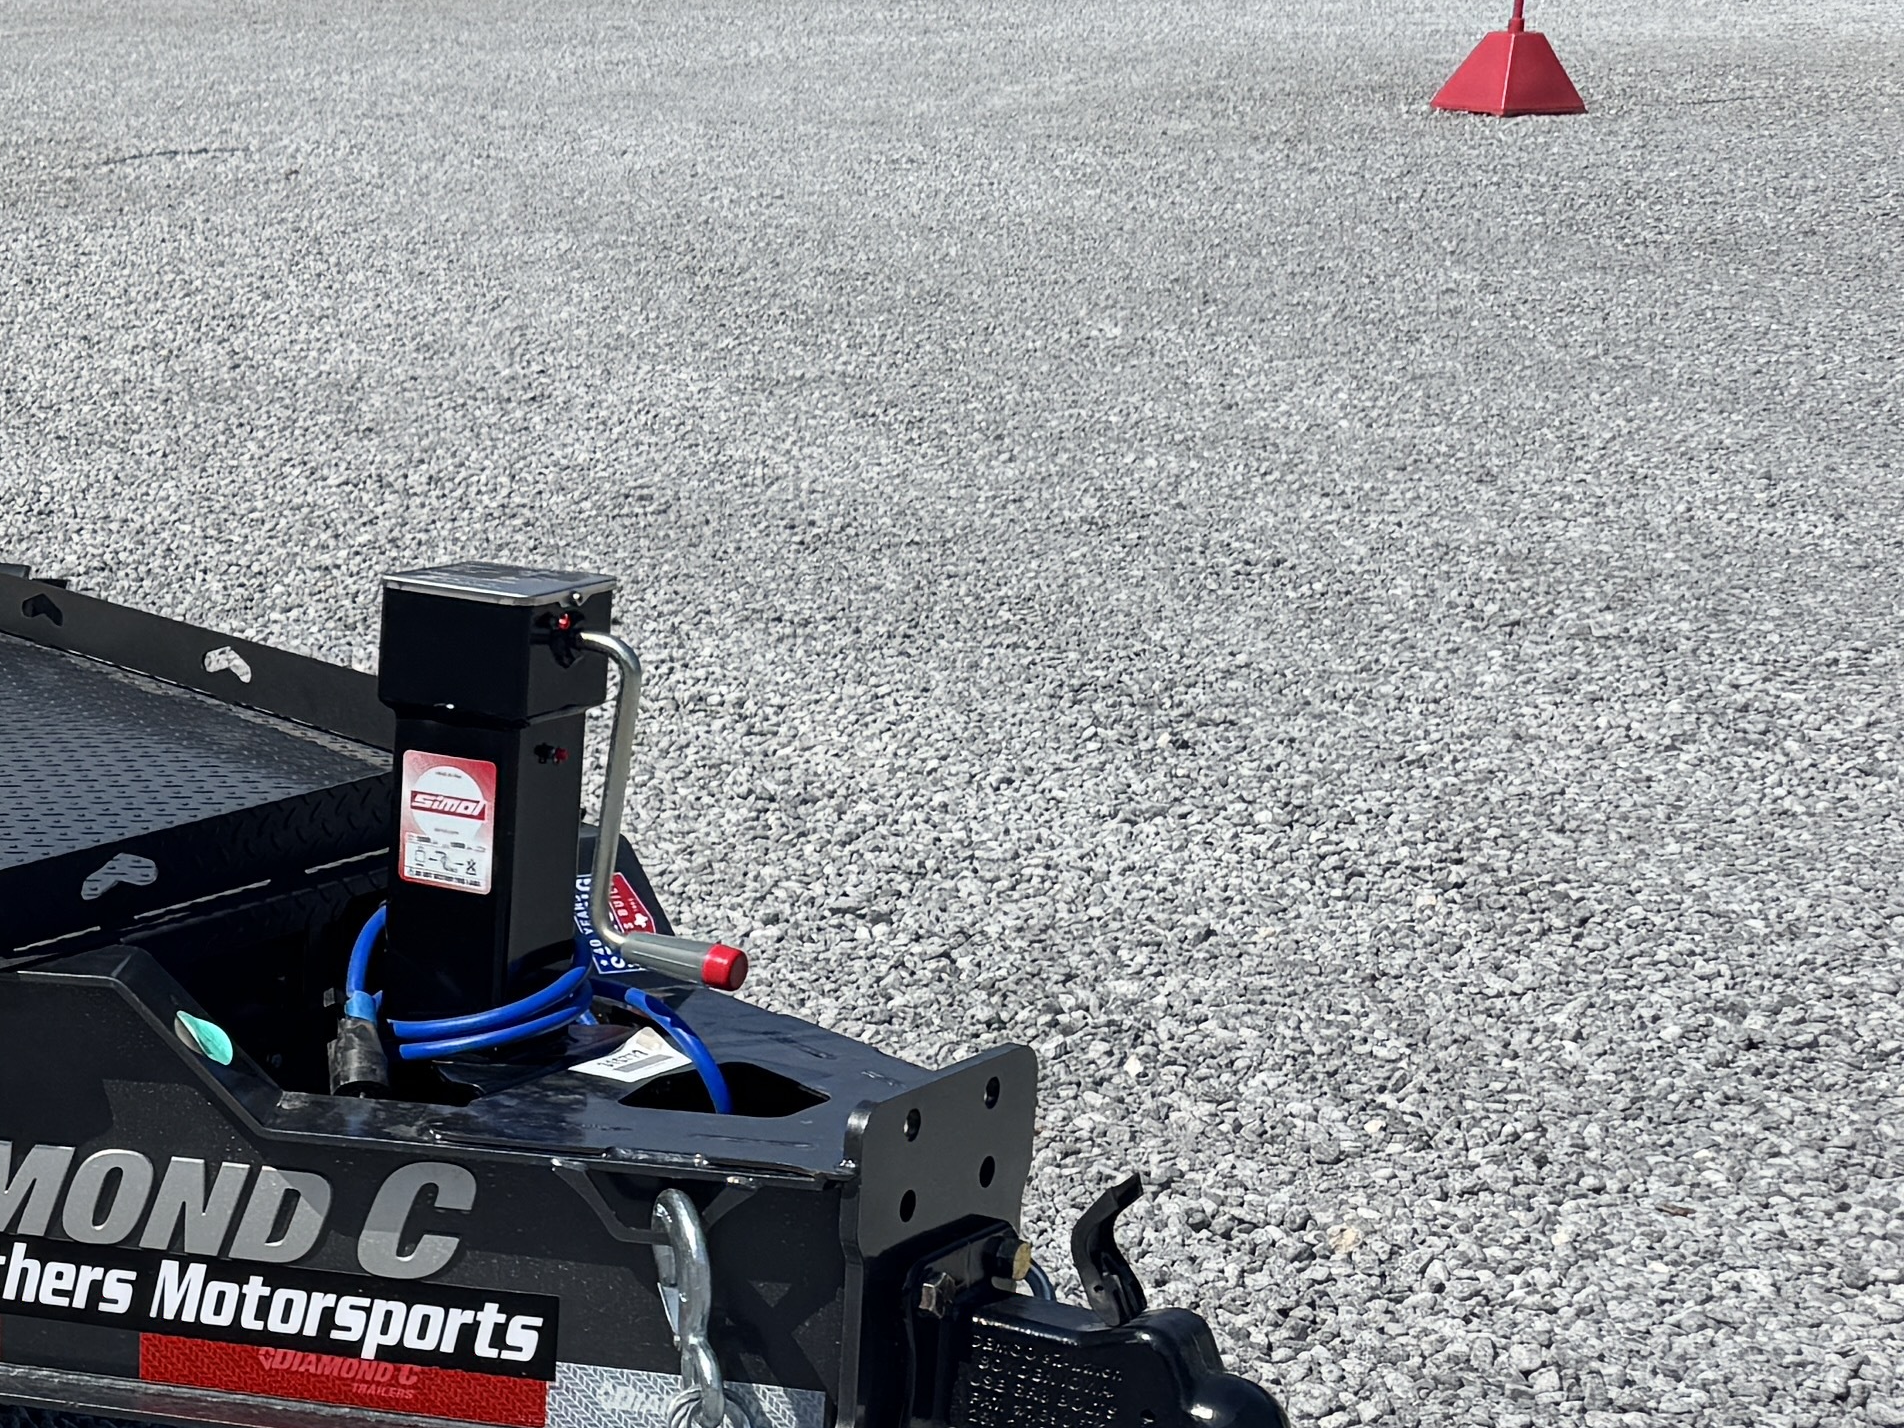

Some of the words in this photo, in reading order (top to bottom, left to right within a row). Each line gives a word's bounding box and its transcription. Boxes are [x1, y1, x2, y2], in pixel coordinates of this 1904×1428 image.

[357, 1161, 477, 1279] C
[149, 1259, 544, 1361] Motorsports
[272, 1349, 394, 1383] DIAMOND
[398, 1364, 421, 1386] C
[352, 1383, 415, 1400] TRAILERS
